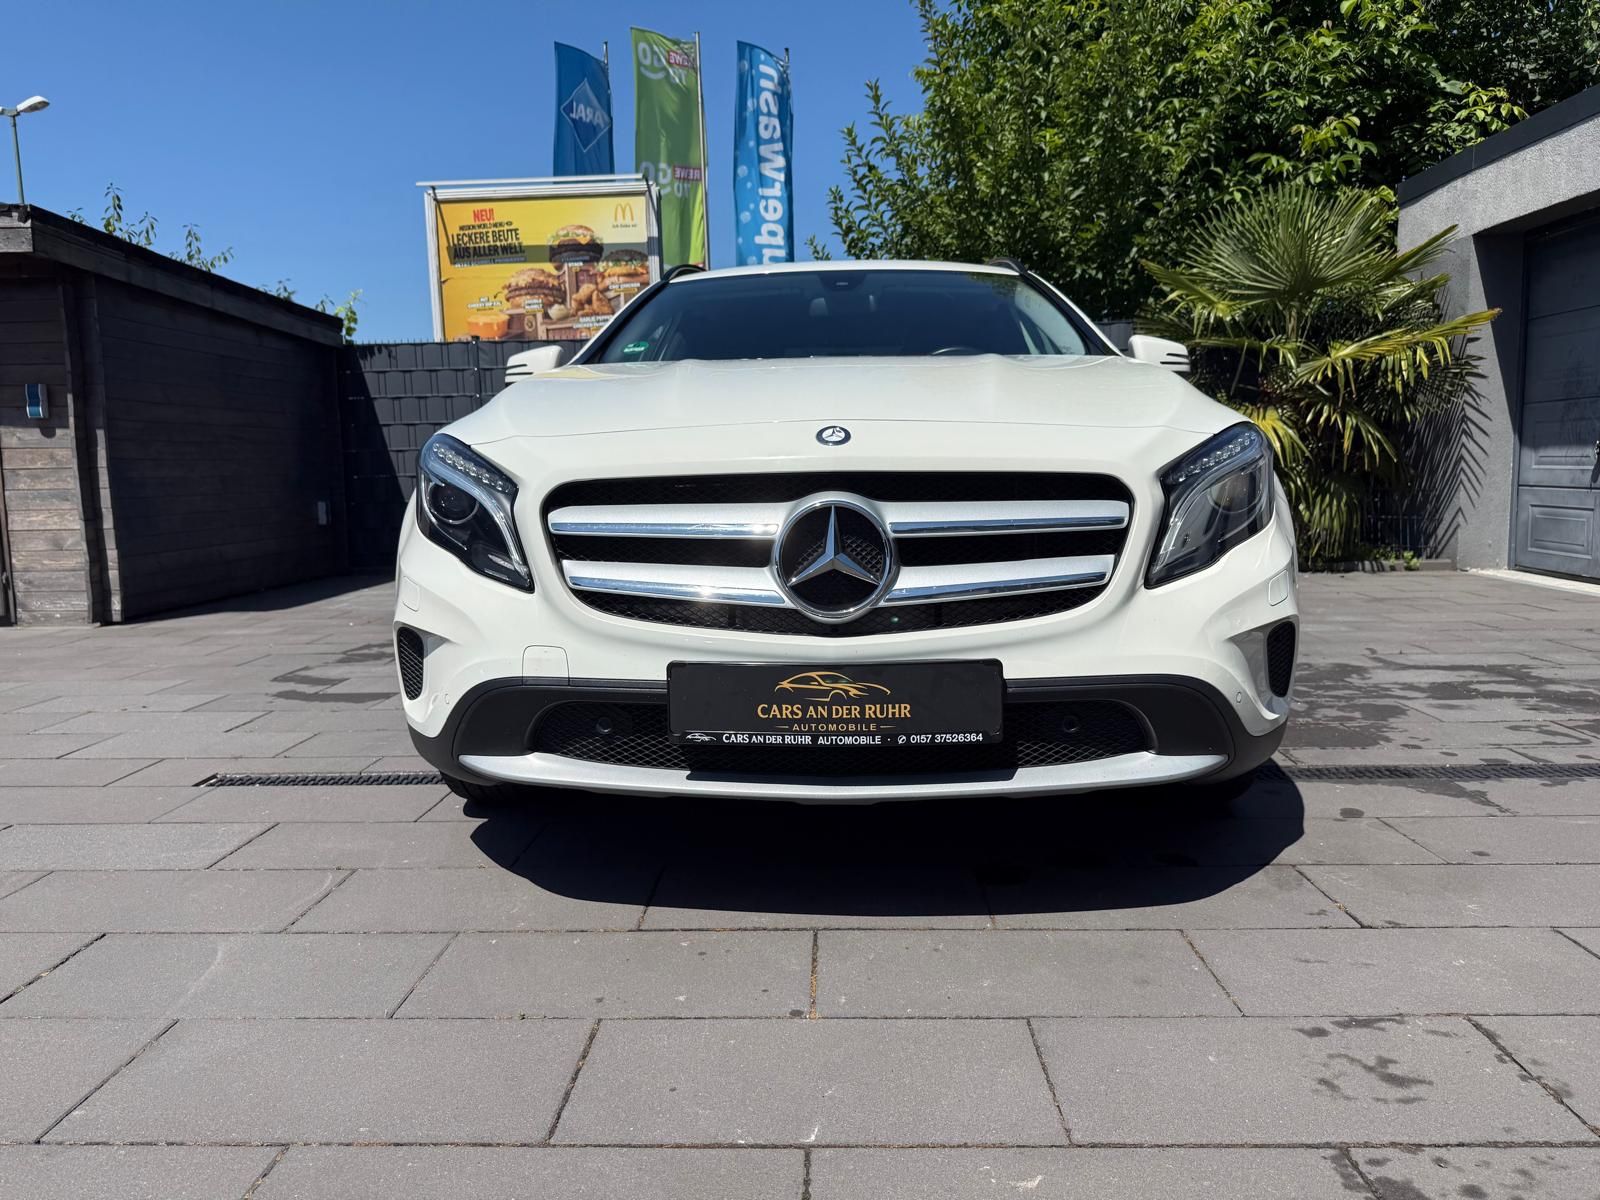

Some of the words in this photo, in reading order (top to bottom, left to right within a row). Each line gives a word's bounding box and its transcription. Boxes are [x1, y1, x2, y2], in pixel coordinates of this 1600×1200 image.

[473, 208, 496, 222] NEU!
[451, 231, 491, 246] LECKERE
[491, 228, 520, 243] BEUTE
[454, 246, 471, 259] AUS
[472, 244, 499, 258] ALLER
[757, 703, 803, 719] CARS
[806, 705, 828, 719] AN
[832, 705, 860, 719] DER
[865, 703, 912, 719] RUHR
[792, 723, 877, 732] AUTOMOBILE
[722, 733, 749, 743] CARS
[751, 735, 764, 744] AN
[766, 735, 783, 744] DER
[784, 734, 812, 745] RUHR
[817, 735, 882, 745] AUTOMOBILE
[910, 734, 932, 744] 0157
[934, 733, 984, 744] 37526364
